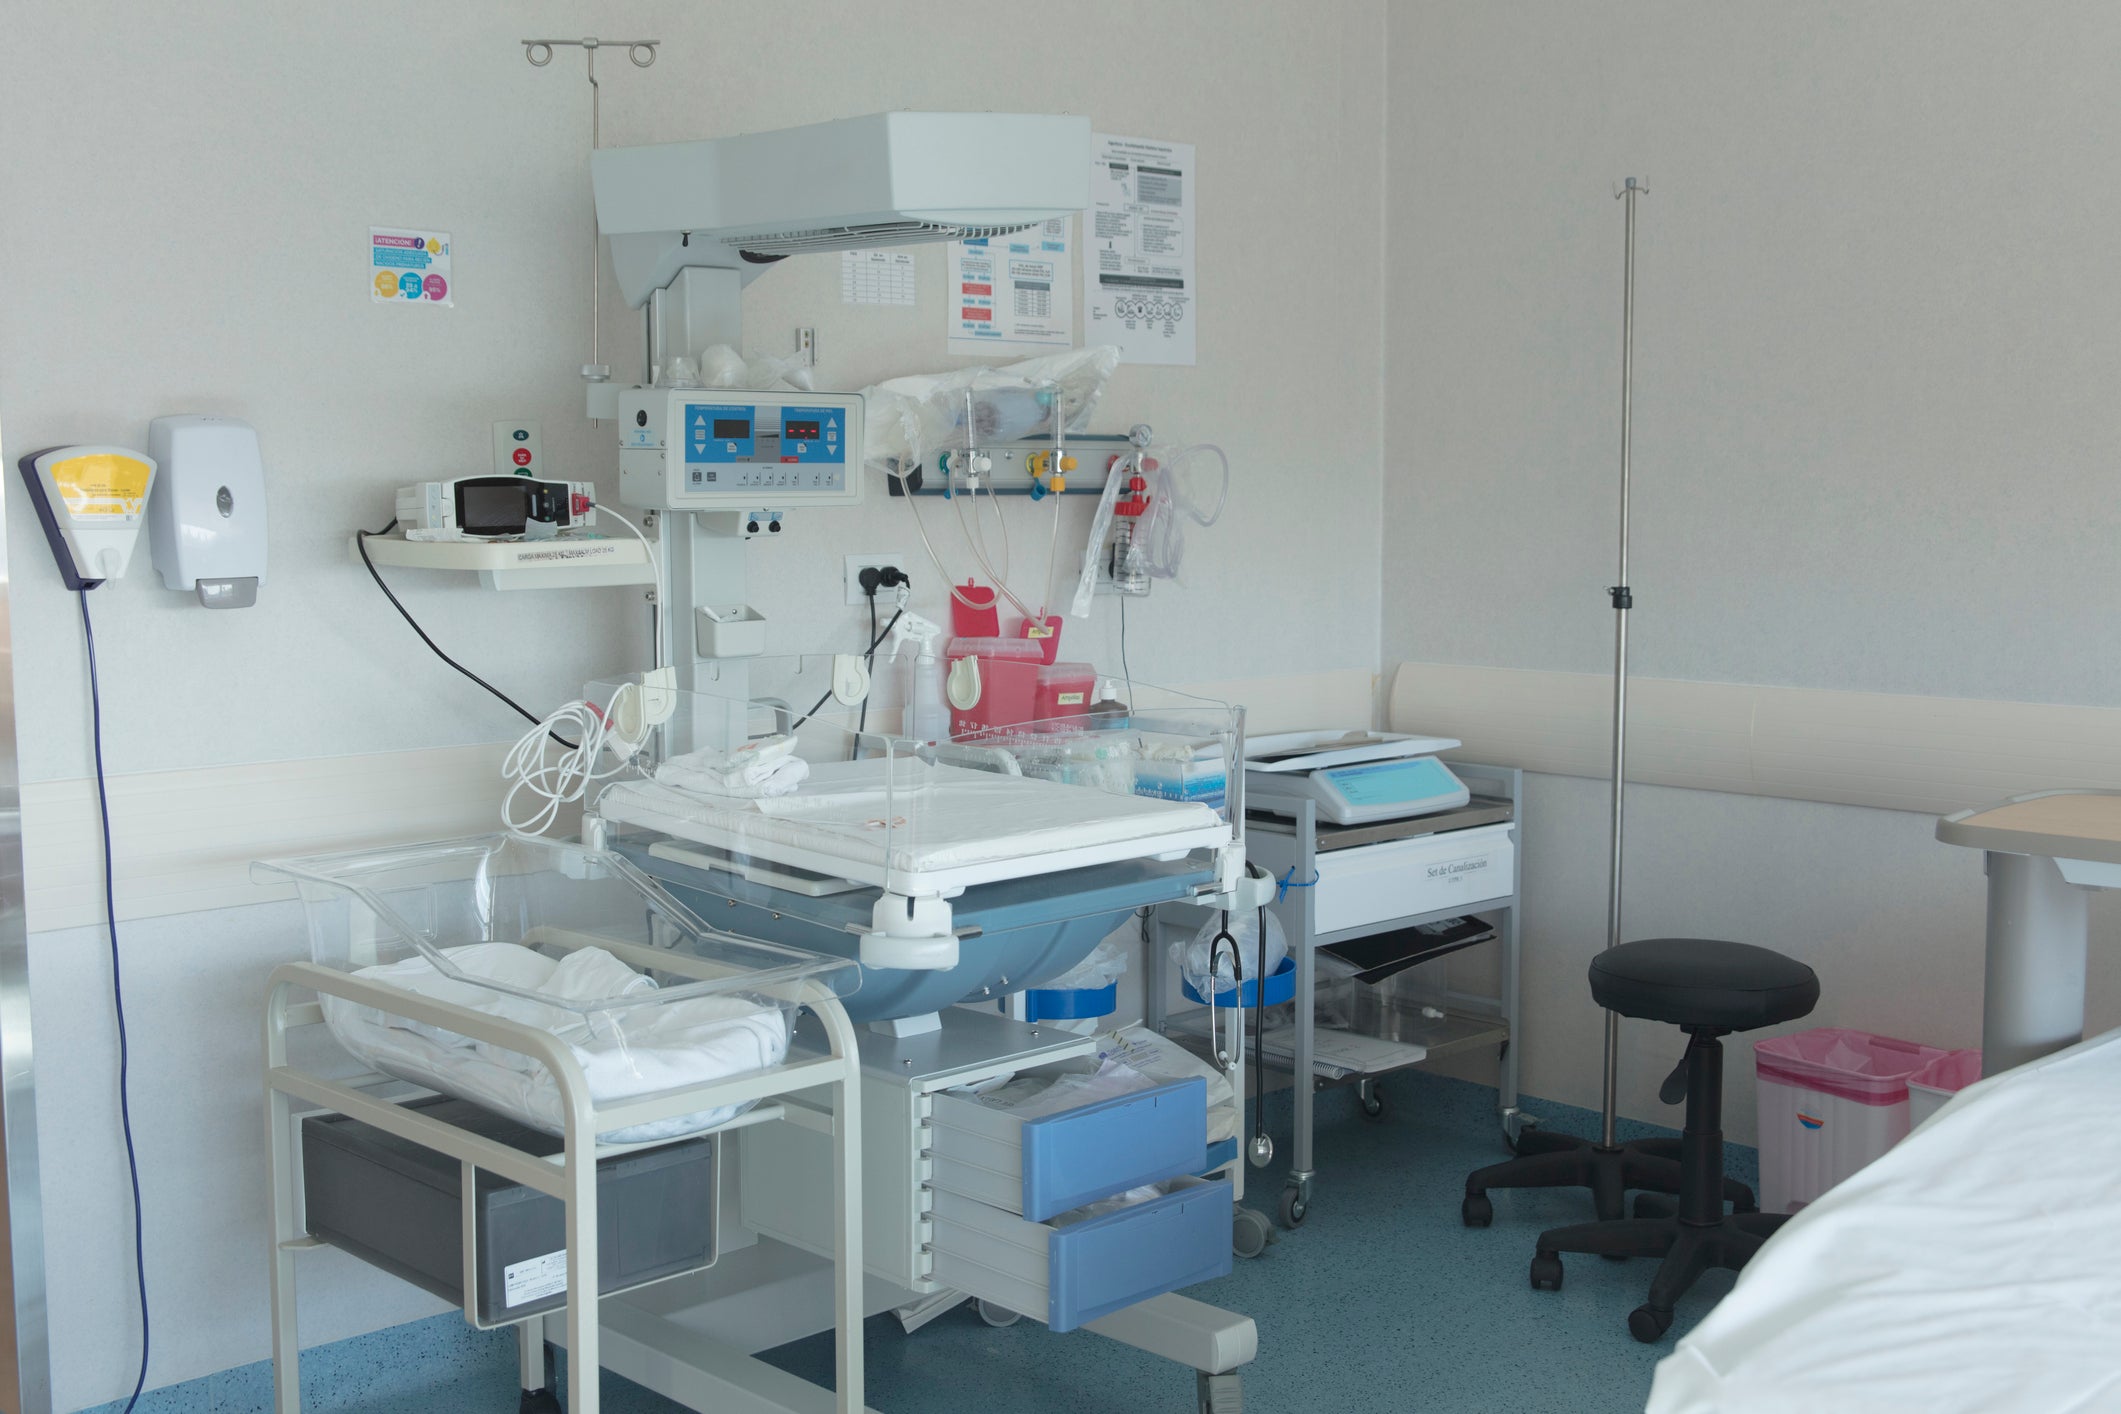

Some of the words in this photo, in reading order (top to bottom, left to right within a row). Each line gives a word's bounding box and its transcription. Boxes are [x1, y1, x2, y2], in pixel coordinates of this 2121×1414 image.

[1427, 867, 1438, 878] Set
[1439, 866, 1447, 875] de
[1448, 858, 1488, 874] Canalización
